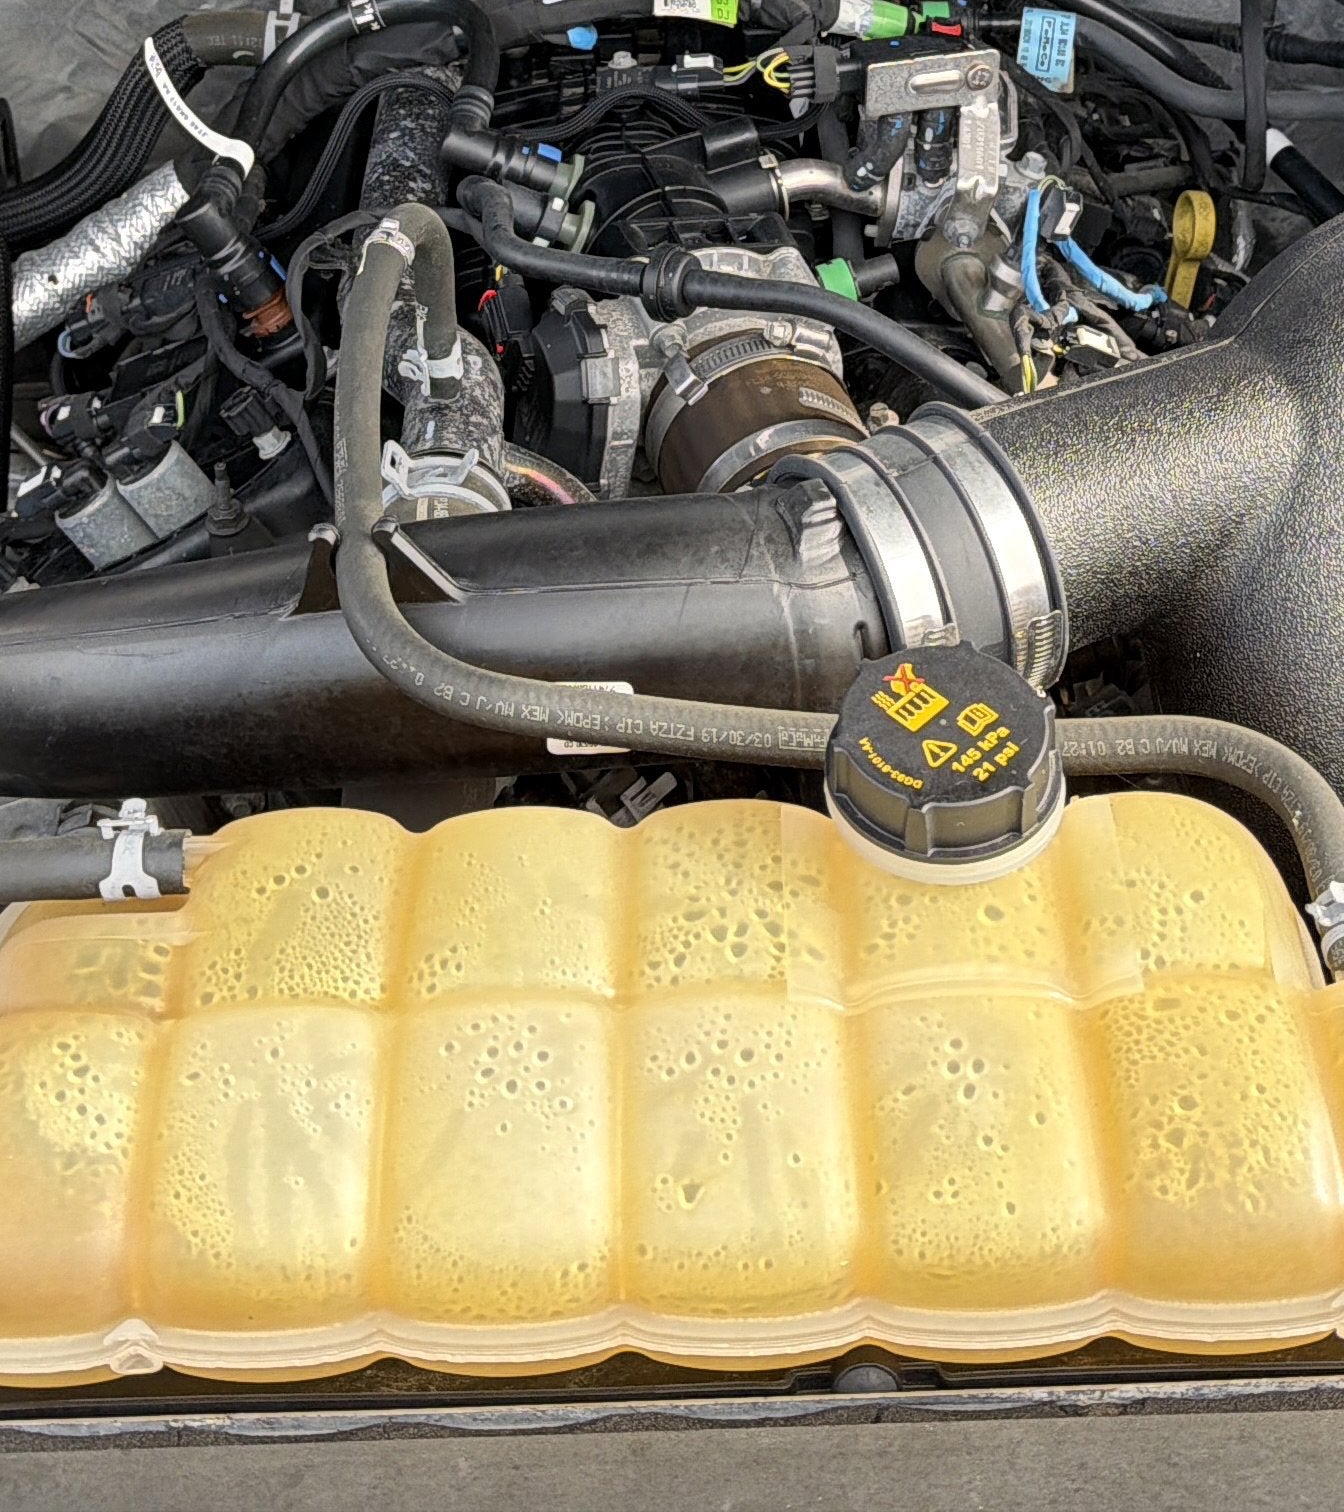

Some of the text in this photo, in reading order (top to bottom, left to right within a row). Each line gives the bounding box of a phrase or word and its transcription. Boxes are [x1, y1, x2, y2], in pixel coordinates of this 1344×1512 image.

[717, 8, 730, 19] DJ
[520, 704, 550, 723] MEX
[616, 717, 643, 734] CIP
[701, 727, 771, 748] 03/30/19
[952, 727, 1011, 773] 145 kPa
[1115, 739, 1136, 756] B2
[972, 741, 1021, 782] 21 psi
